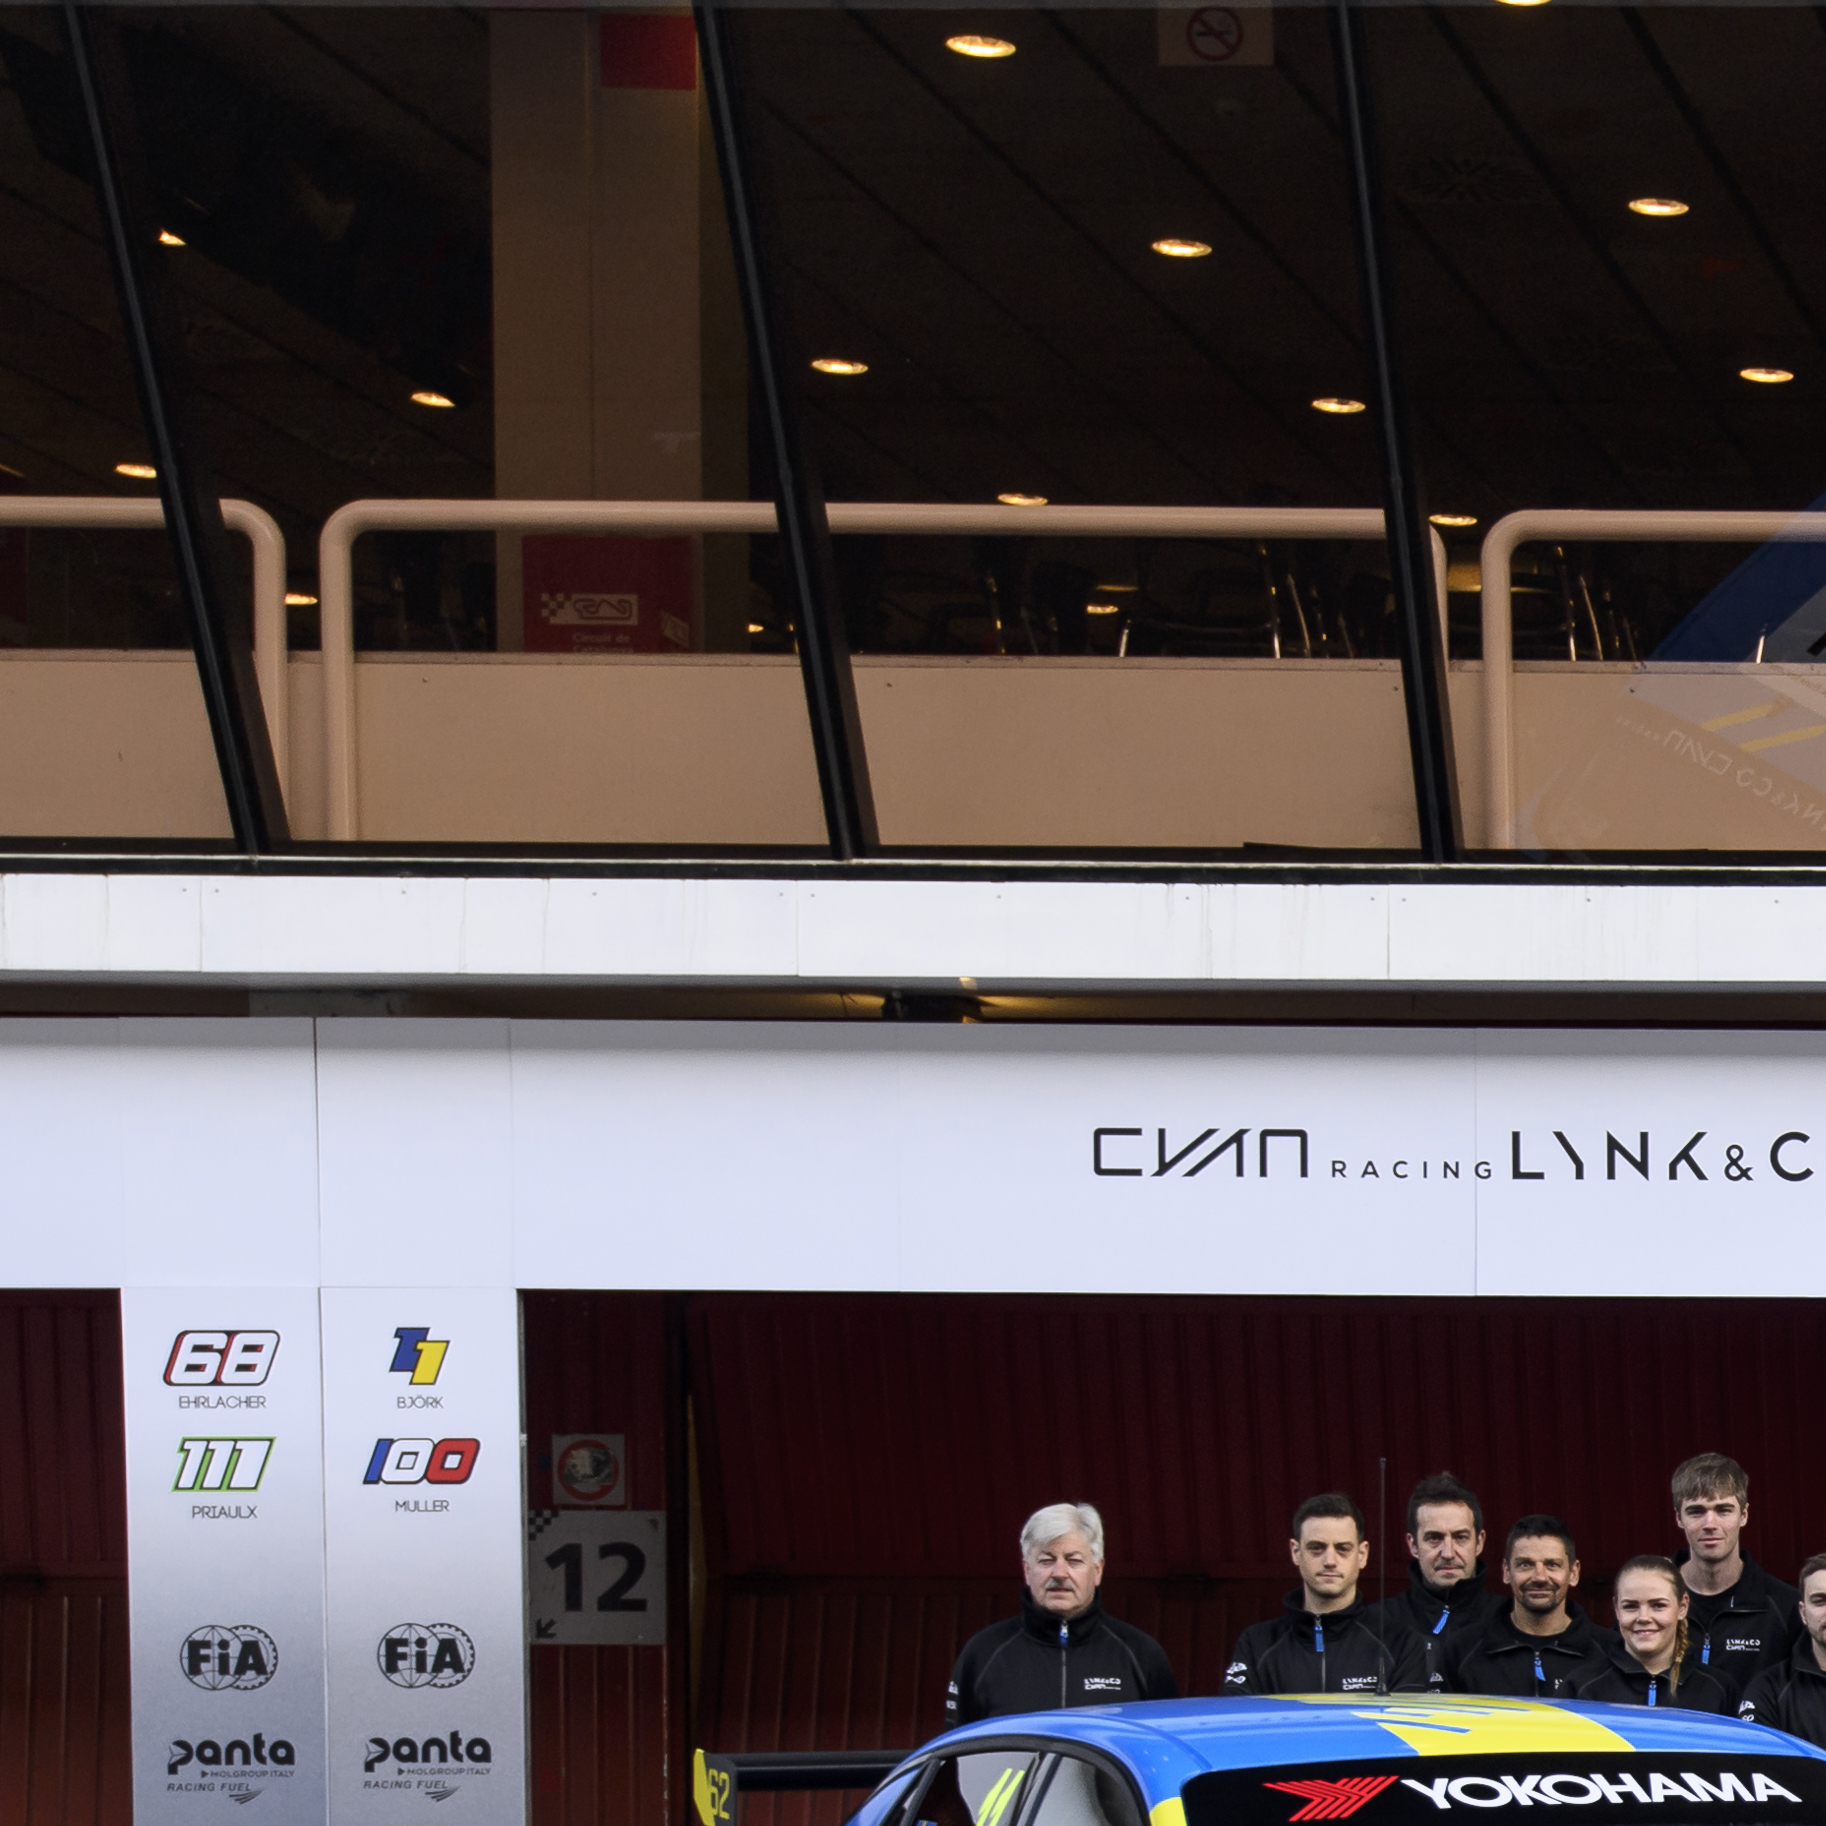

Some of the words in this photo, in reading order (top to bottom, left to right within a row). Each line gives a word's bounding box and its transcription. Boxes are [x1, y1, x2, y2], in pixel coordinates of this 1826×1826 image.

[1093, 1128, 1308, 1177] CYAN
[1332, 1159, 1493, 1179] RACING
[163, 1330, 280, 1386] 68
[389, 1327, 450, 1385] 11
[179, 1396, 266, 1408] EHRLACHER
[397, 1394, 443, 1408] BJÖRK
[171, 1436, 276, 1492] 111
[362, 1438, 480, 1484] 100
[192, 1505, 257, 1518] PRIAULX
[395, 1500, 450, 1512] MULLER
[545, 1542, 647, 1613] 12
[168, 1732, 295, 1775] panta
[364, 1730, 492, 1773] panta
[167, 1782, 216, 1792] RACING
[220, 1782, 251, 1792] FUEL
[363, 1780, 411, 1790] RACING
[416, 1780, 448, 1790] FUEL
[709, 1771, 730, 1820] 62
[1401, 1772, 1802, 1810] YOKOHAMA
